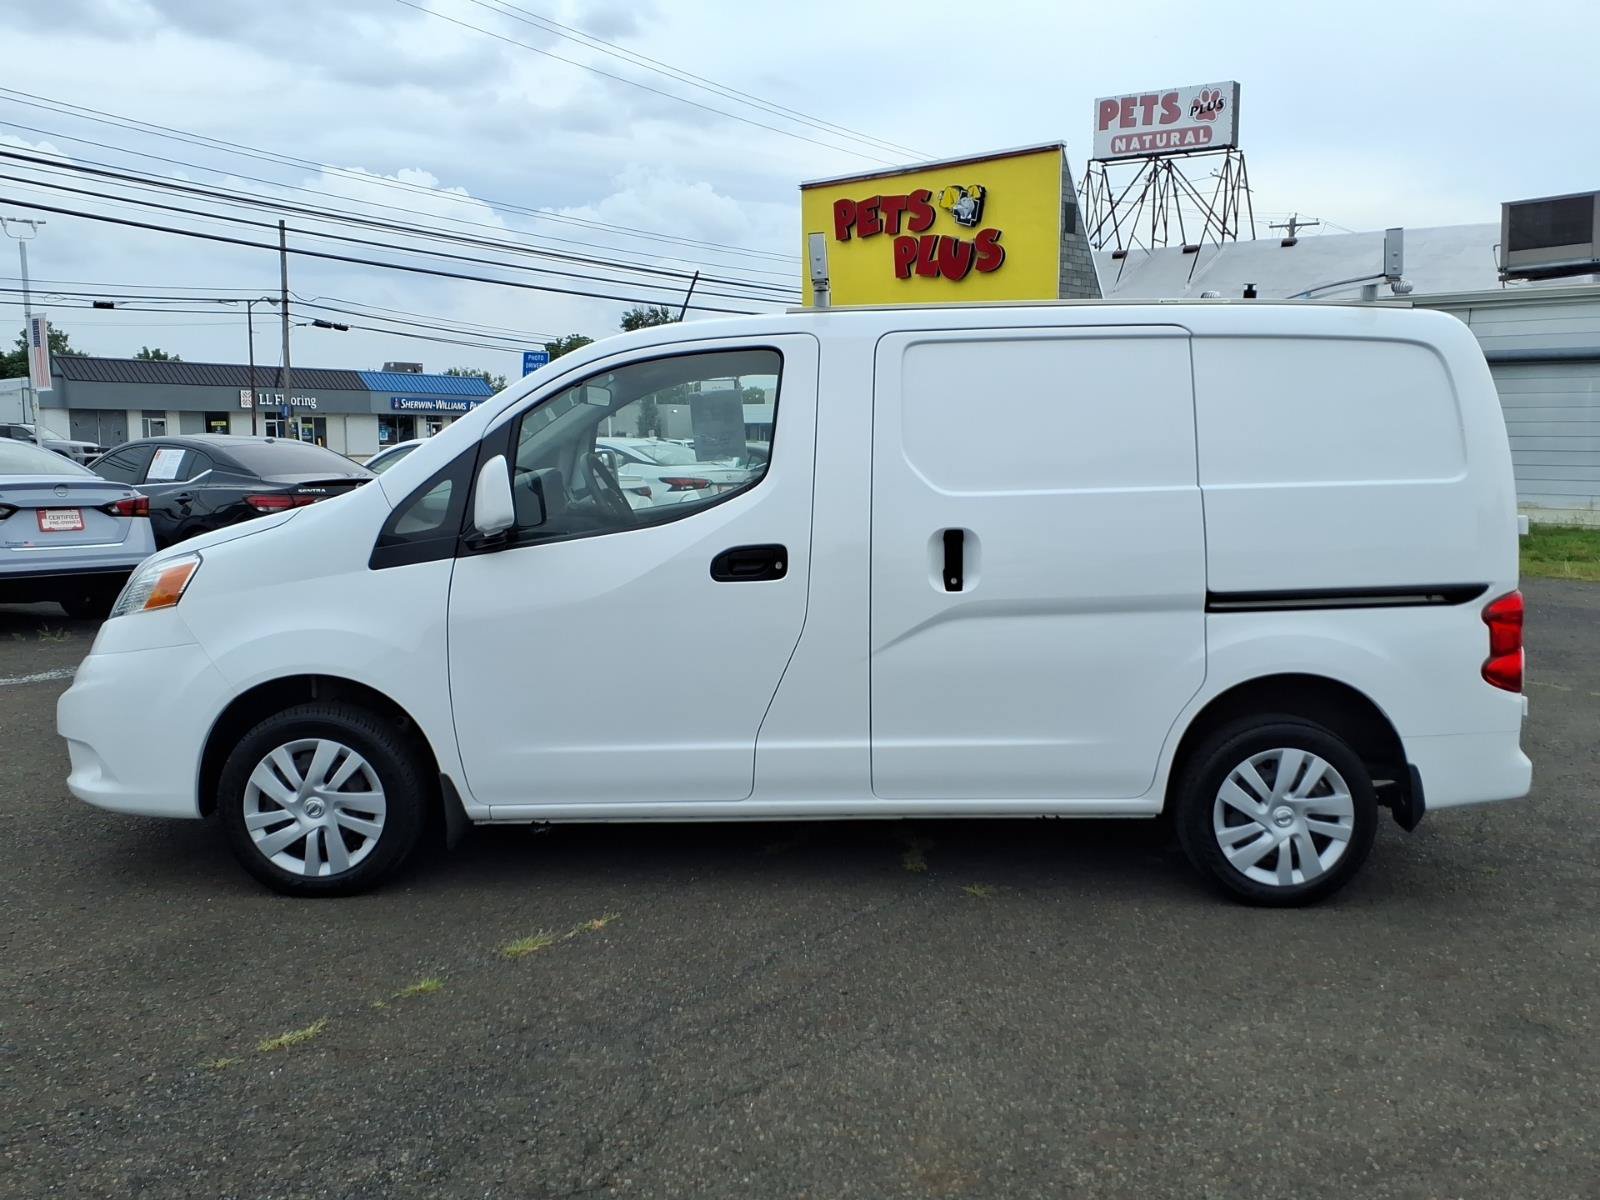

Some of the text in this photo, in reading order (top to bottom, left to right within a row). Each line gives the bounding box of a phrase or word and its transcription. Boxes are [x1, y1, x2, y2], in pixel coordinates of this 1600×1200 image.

[1099, 92, 1225, 130] PETS PLUS
[1114, 129, 1209, 152] NATURAL
[832, 188, 937, 242] PETS
[893, 228, 1006, 281] PLUS
[258, 393, 317, 409] LL Floring
[400, 398, 467, 410] SHERWIN-WILLIAMS
